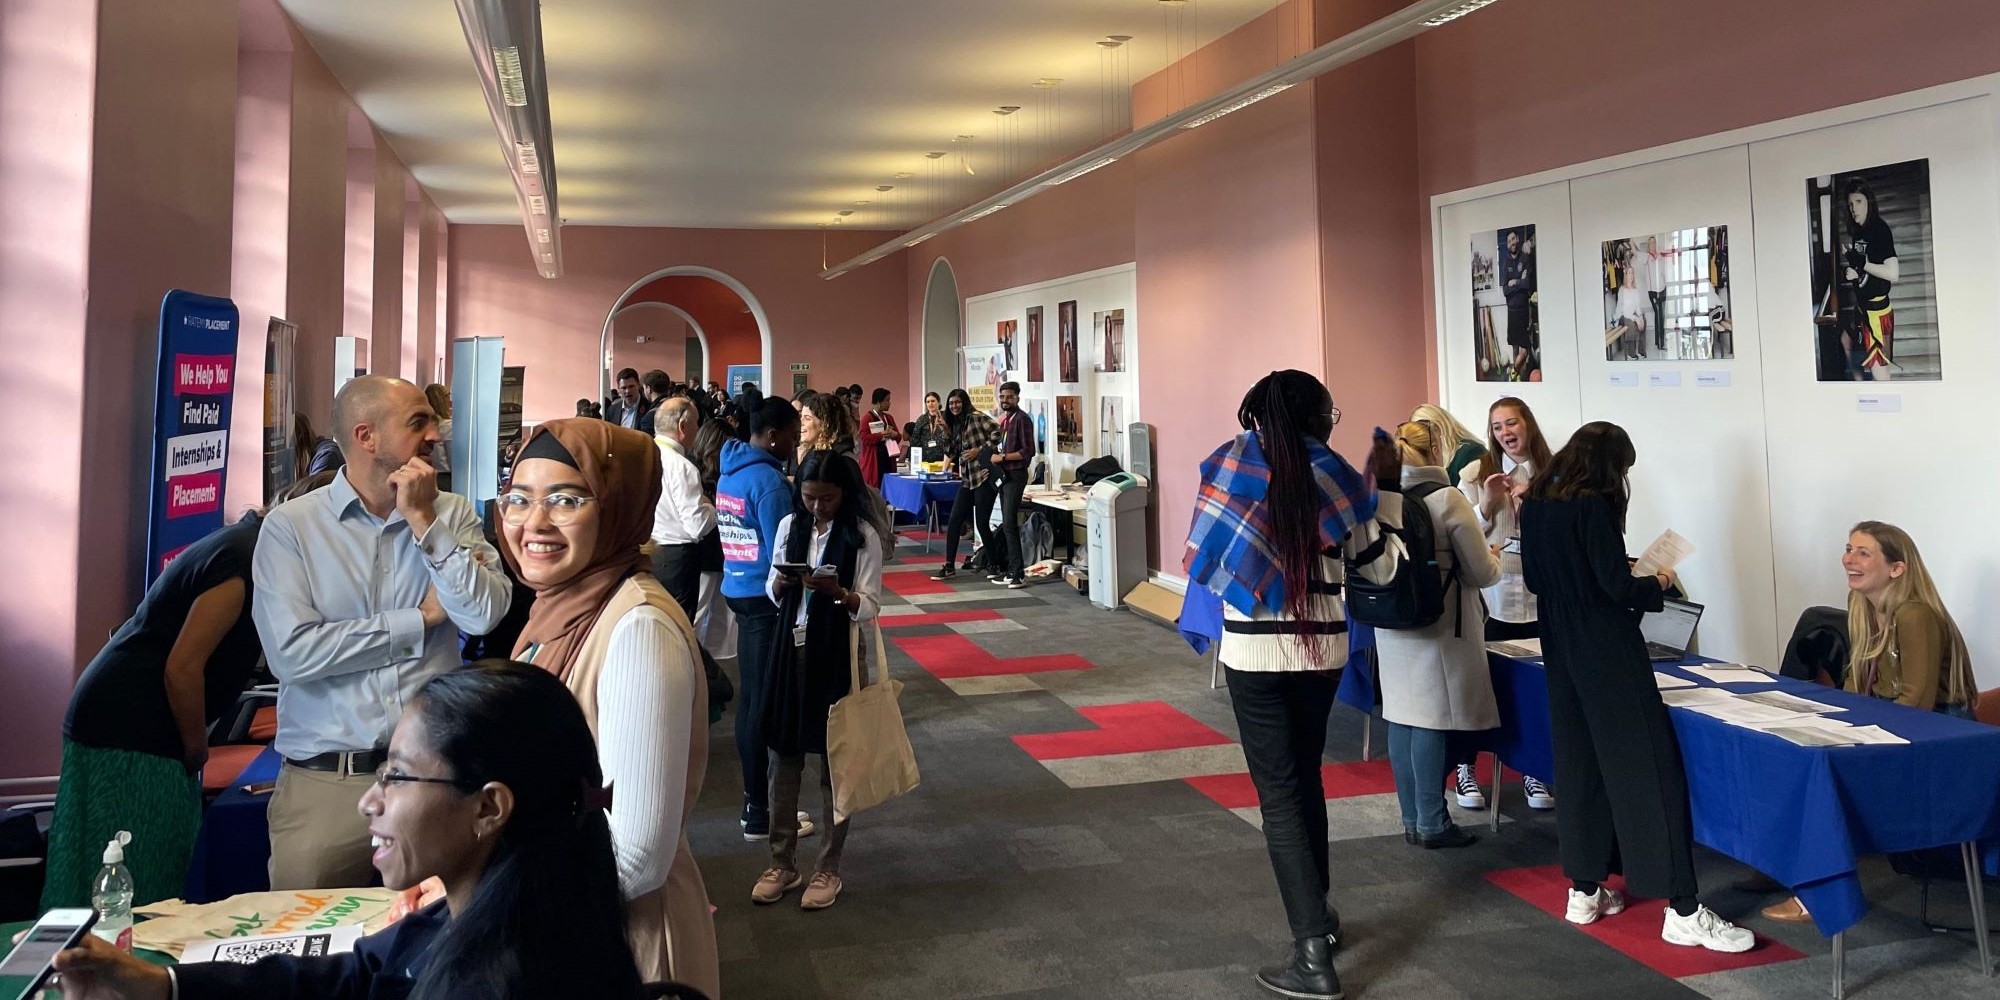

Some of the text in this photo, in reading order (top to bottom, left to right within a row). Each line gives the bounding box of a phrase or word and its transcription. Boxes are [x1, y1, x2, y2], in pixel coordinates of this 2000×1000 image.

[181, 364, 229, 390] We Help You
[184, 401, 220, 425] Find Paid
[172, 439, 222, 469] Internships &
[173, 483, 216, 508] Placements
